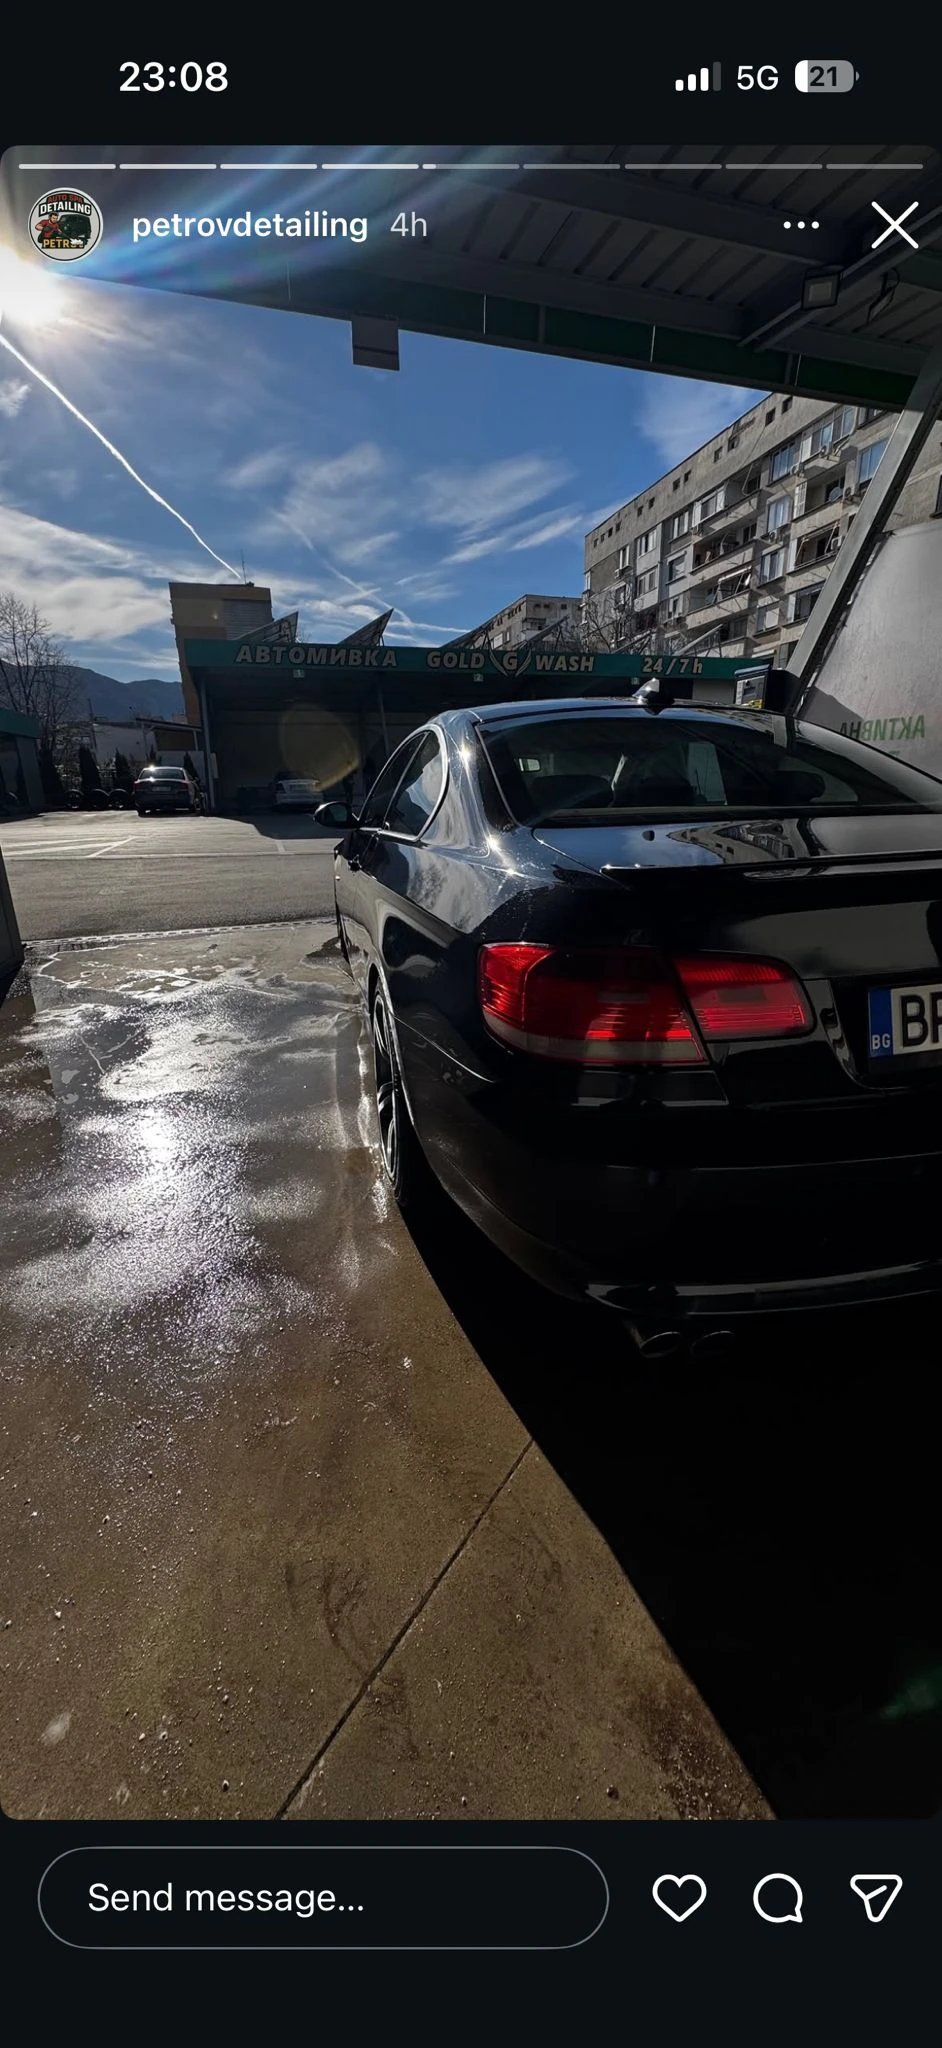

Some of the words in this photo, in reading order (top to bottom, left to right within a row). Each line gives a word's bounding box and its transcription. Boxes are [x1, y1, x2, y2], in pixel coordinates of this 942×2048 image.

[235, 645, 397, 668] АВТОМИВКА
[426, 651, 485, 669] GOLD
[502, 651, 519, 670] G
[535, 654, 595, 672] WASH
[872, 1033, 891, 1050] BG
